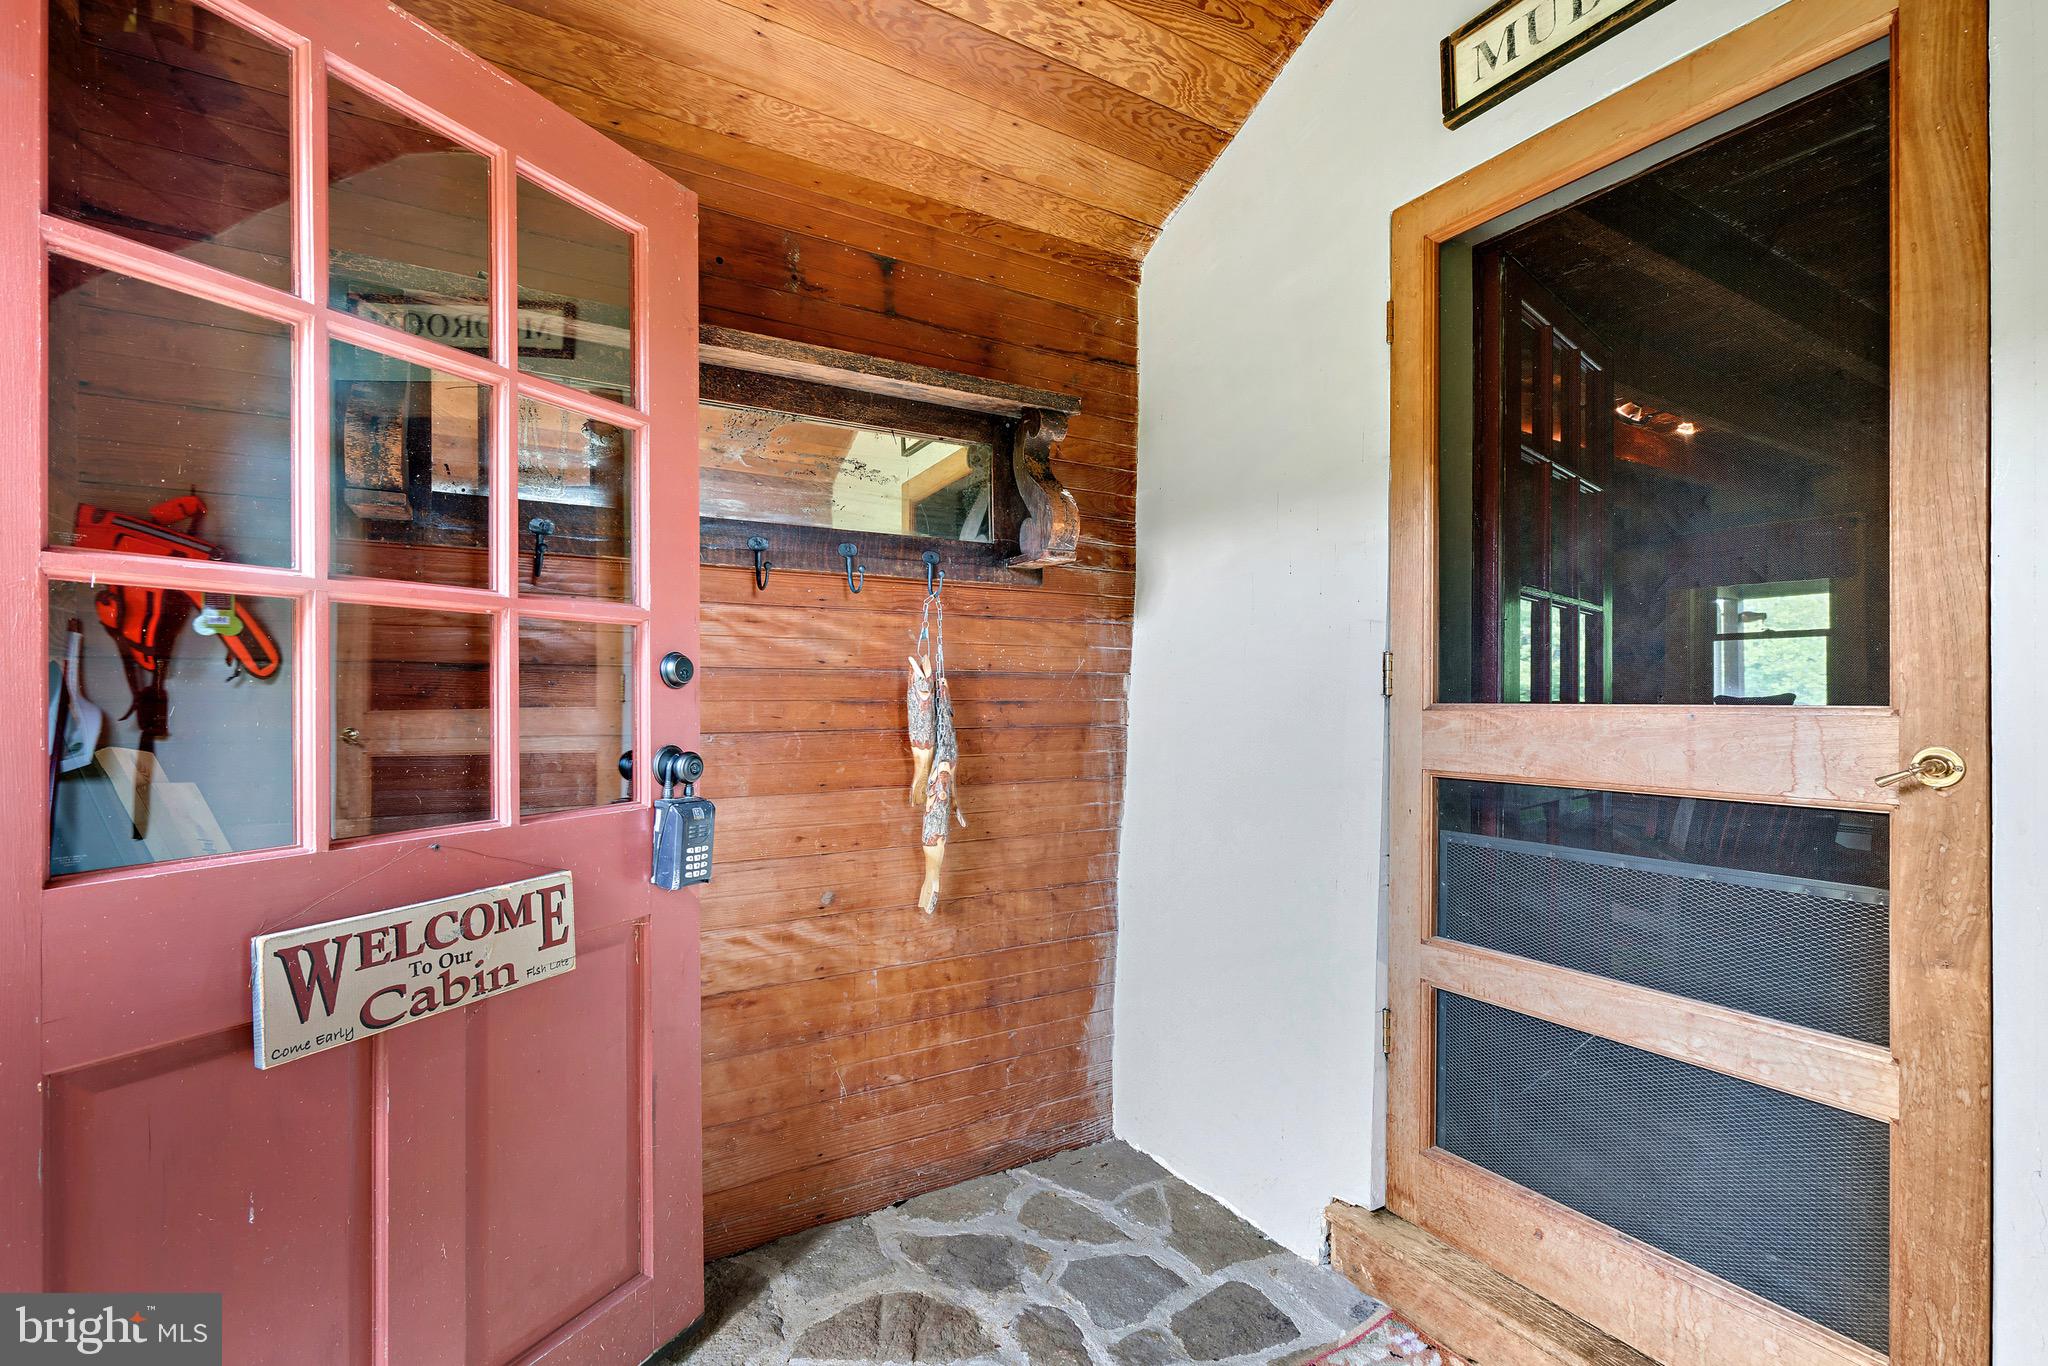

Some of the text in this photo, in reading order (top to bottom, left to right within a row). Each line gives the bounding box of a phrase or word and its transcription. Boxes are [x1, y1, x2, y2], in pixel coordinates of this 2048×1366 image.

[273, 883, 570, 1025] WELCOME
[408, 949, 473, 978] To Our
[359, 959, 519, 1030] Cabin
[271, 1025, 355, 1061] Come Early
